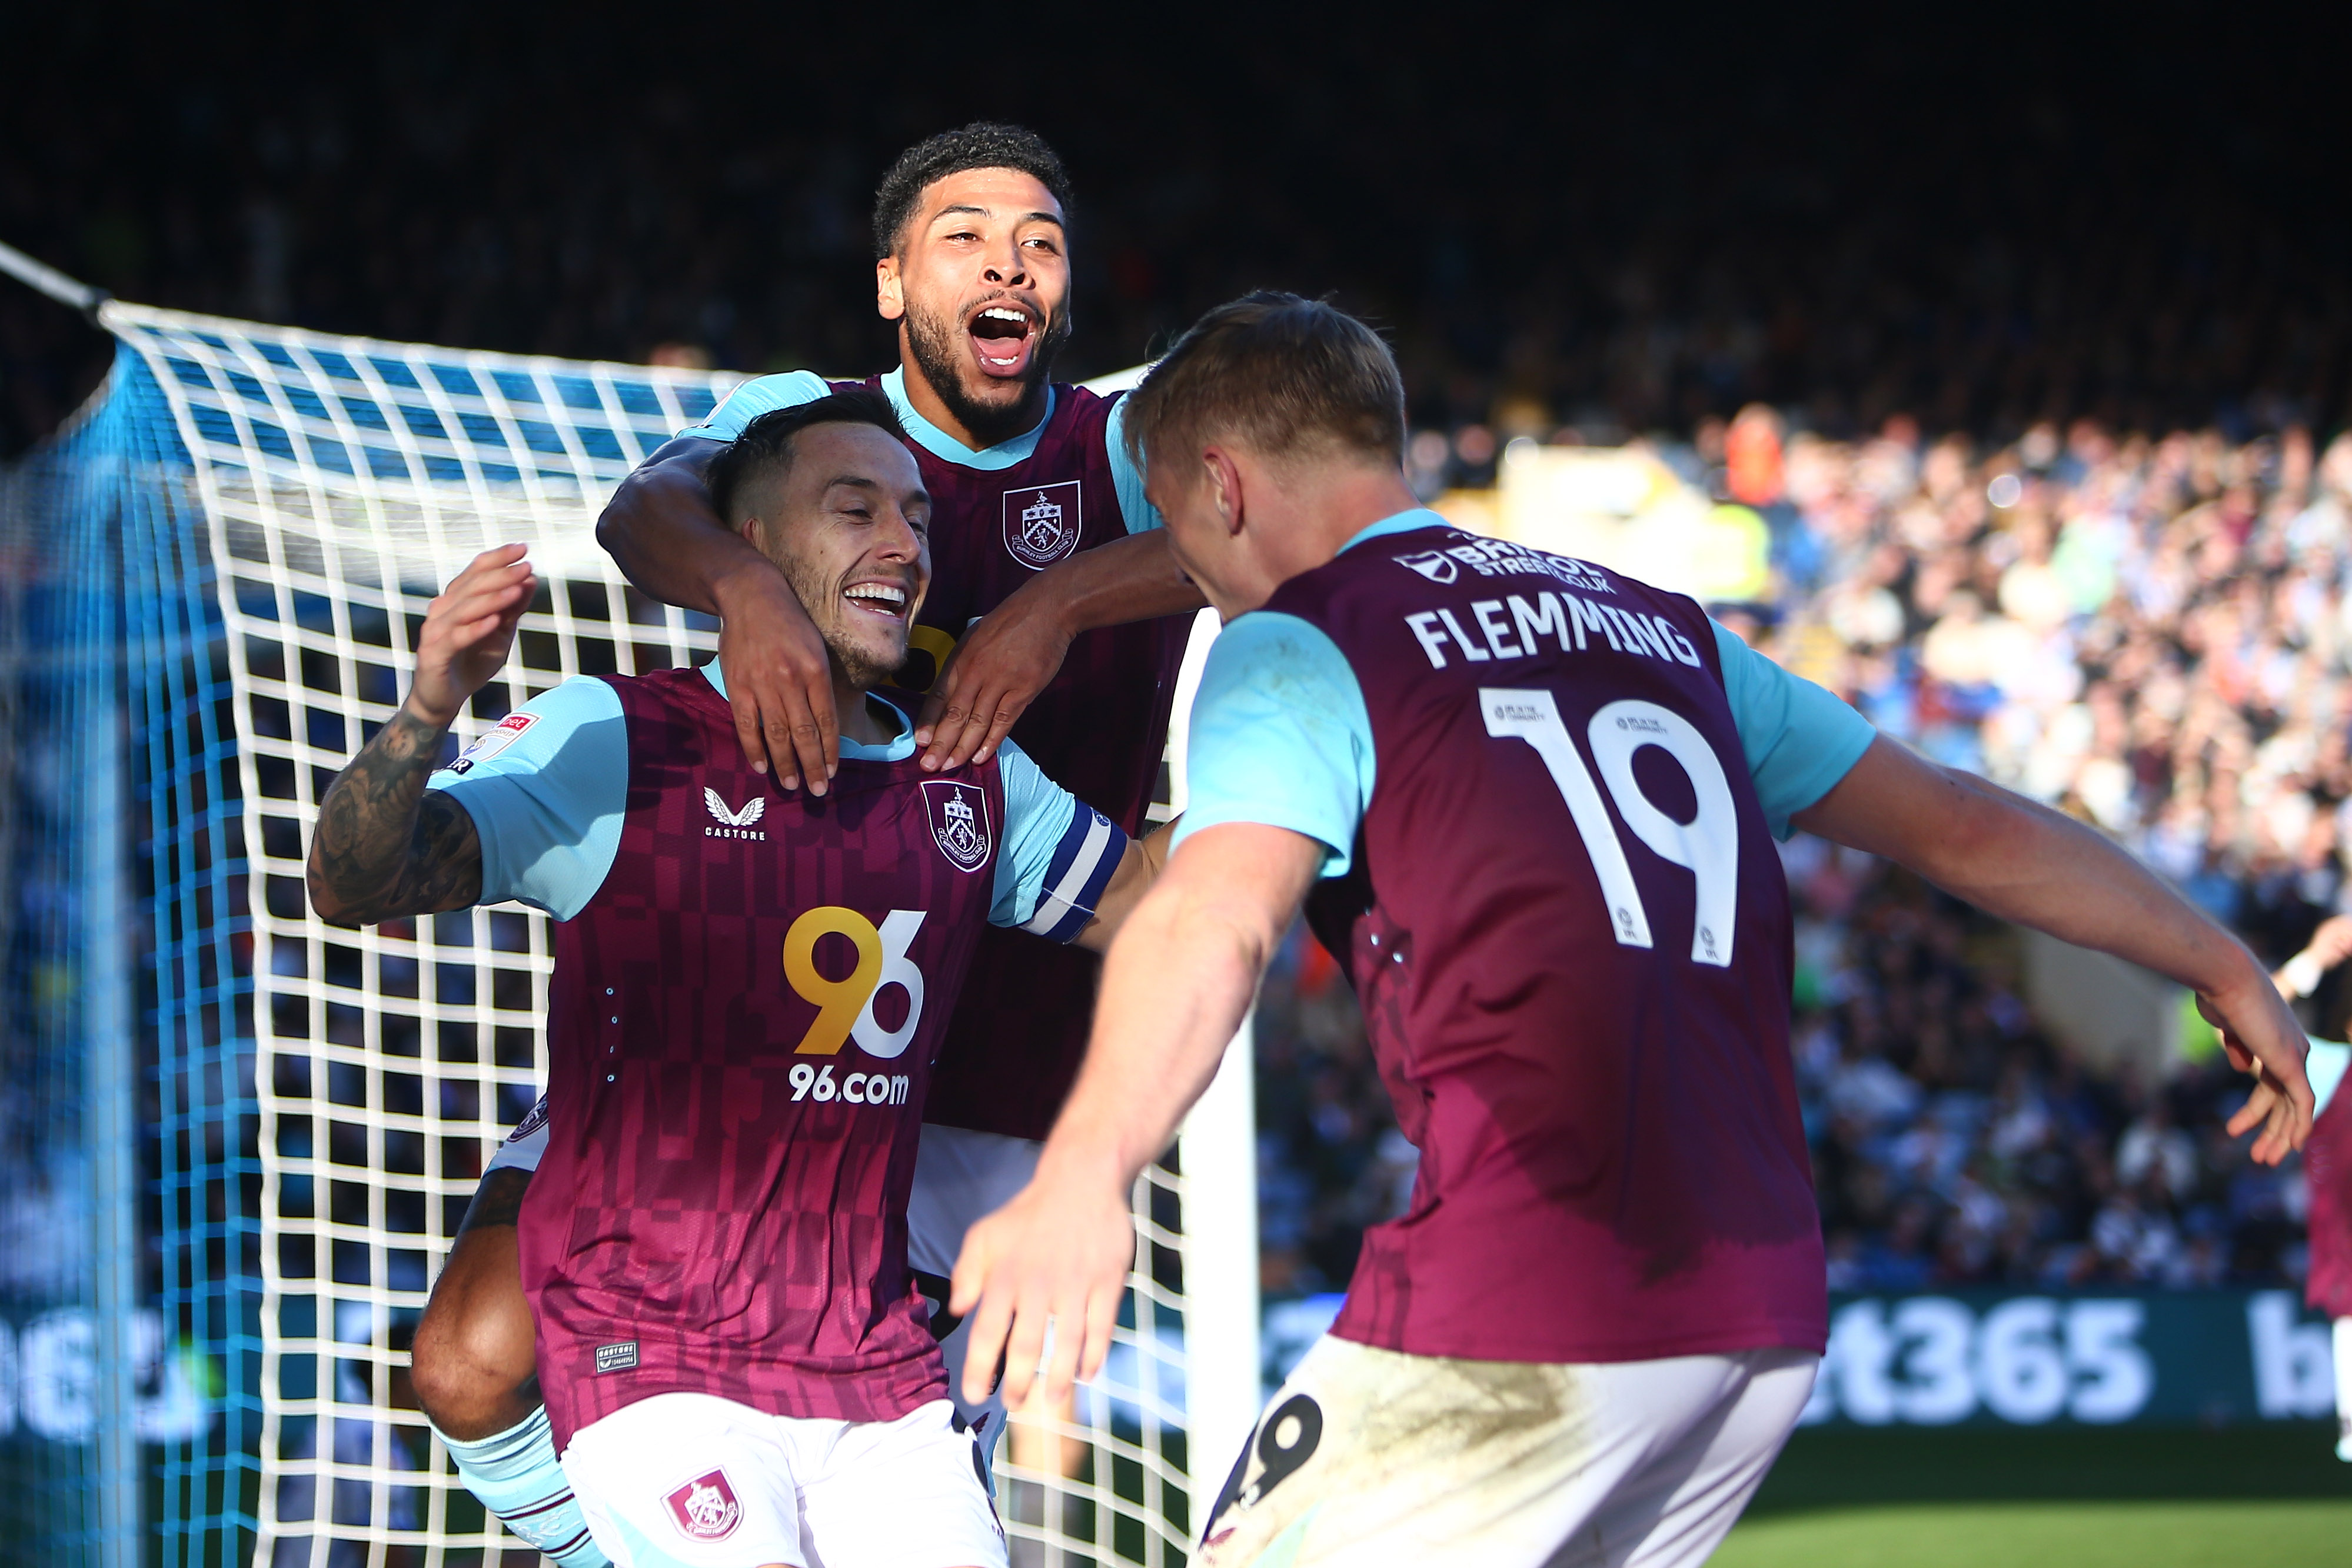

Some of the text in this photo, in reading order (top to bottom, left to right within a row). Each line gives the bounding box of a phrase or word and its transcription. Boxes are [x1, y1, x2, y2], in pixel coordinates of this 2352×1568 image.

[1036, 550, 1058, 560] FOOTBALL
[1405, 592, 1701, 669] FLEMMING
[706, 827, 765, 841] CASTORE
[1478, 687, 1739, 967] 19
[783, 906, 927, 1058] 96
[789, 1064, 909, 1105] 96.com
